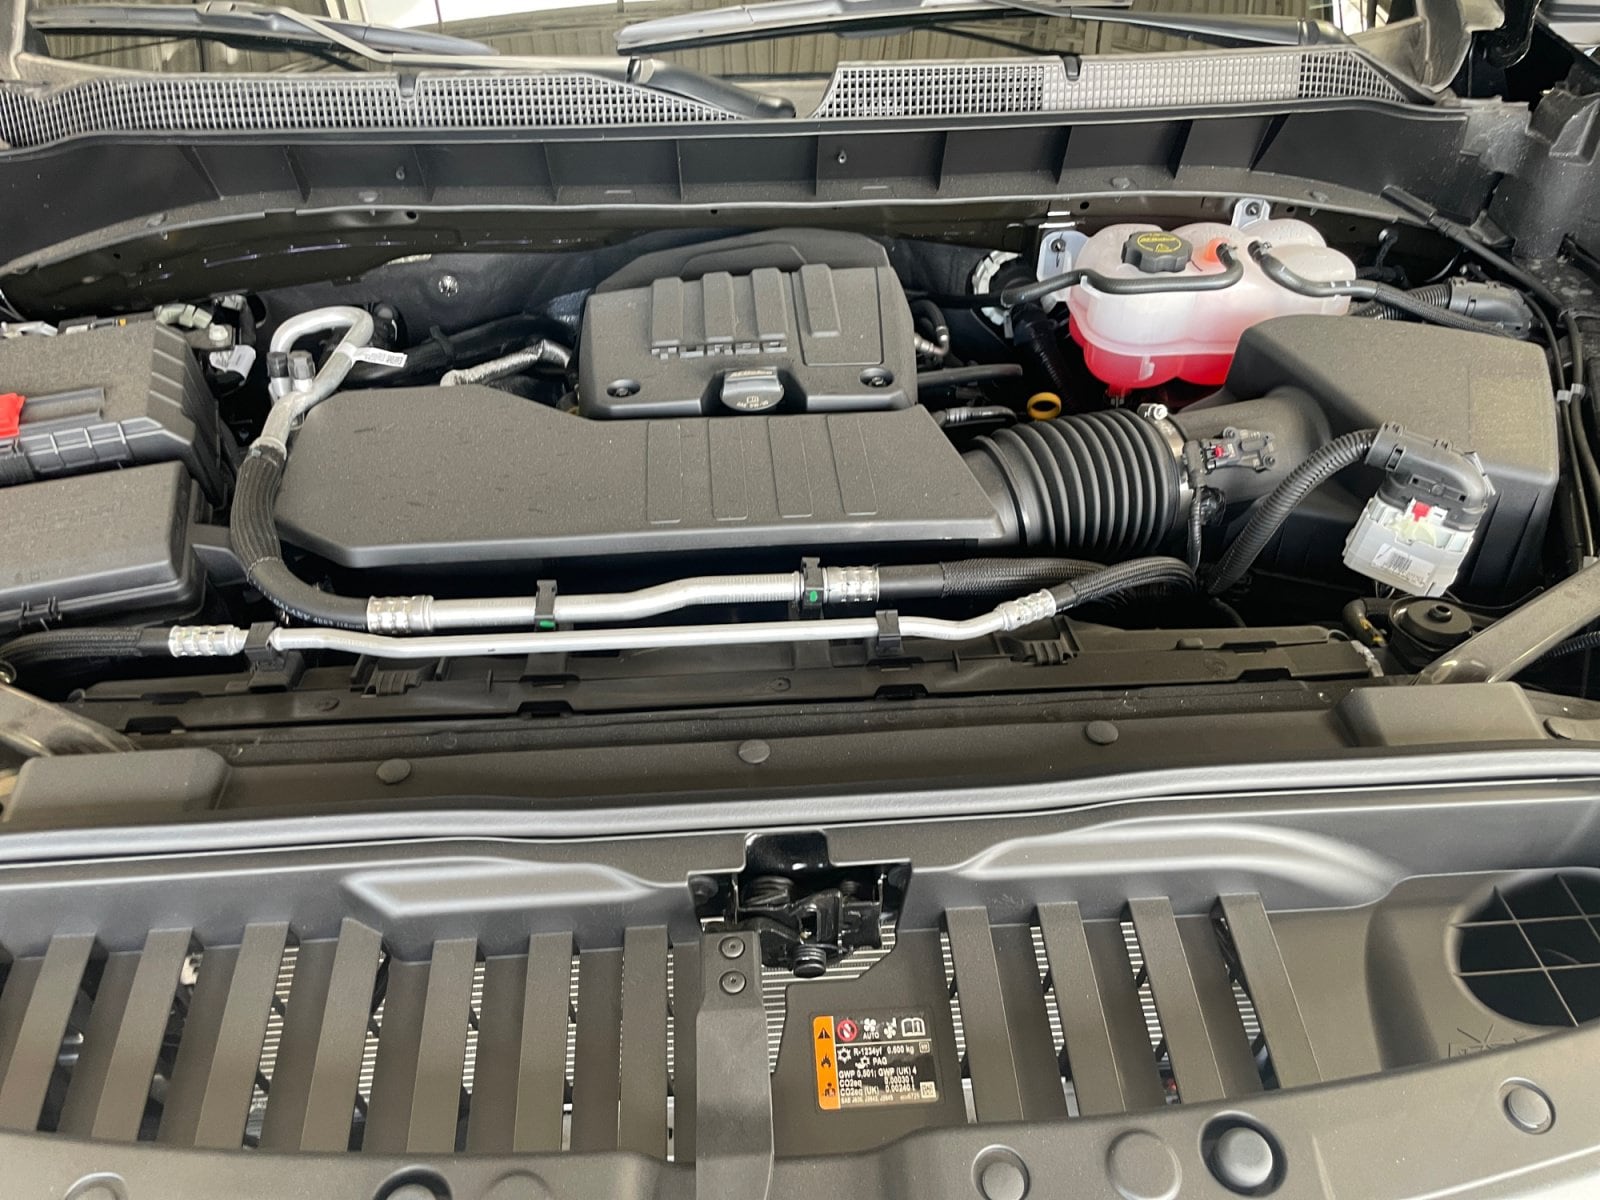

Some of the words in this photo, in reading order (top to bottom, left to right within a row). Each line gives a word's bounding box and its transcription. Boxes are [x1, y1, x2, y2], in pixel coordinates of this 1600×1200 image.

[862, 1032, 880, 1040] AUTO
[906, 1044, 915, 1055] kg
[896, 1066, 911, 1076] (UK)
[912, 1065, 917, 1075] 4
[864, 1085, 880, 1096] (UK)
